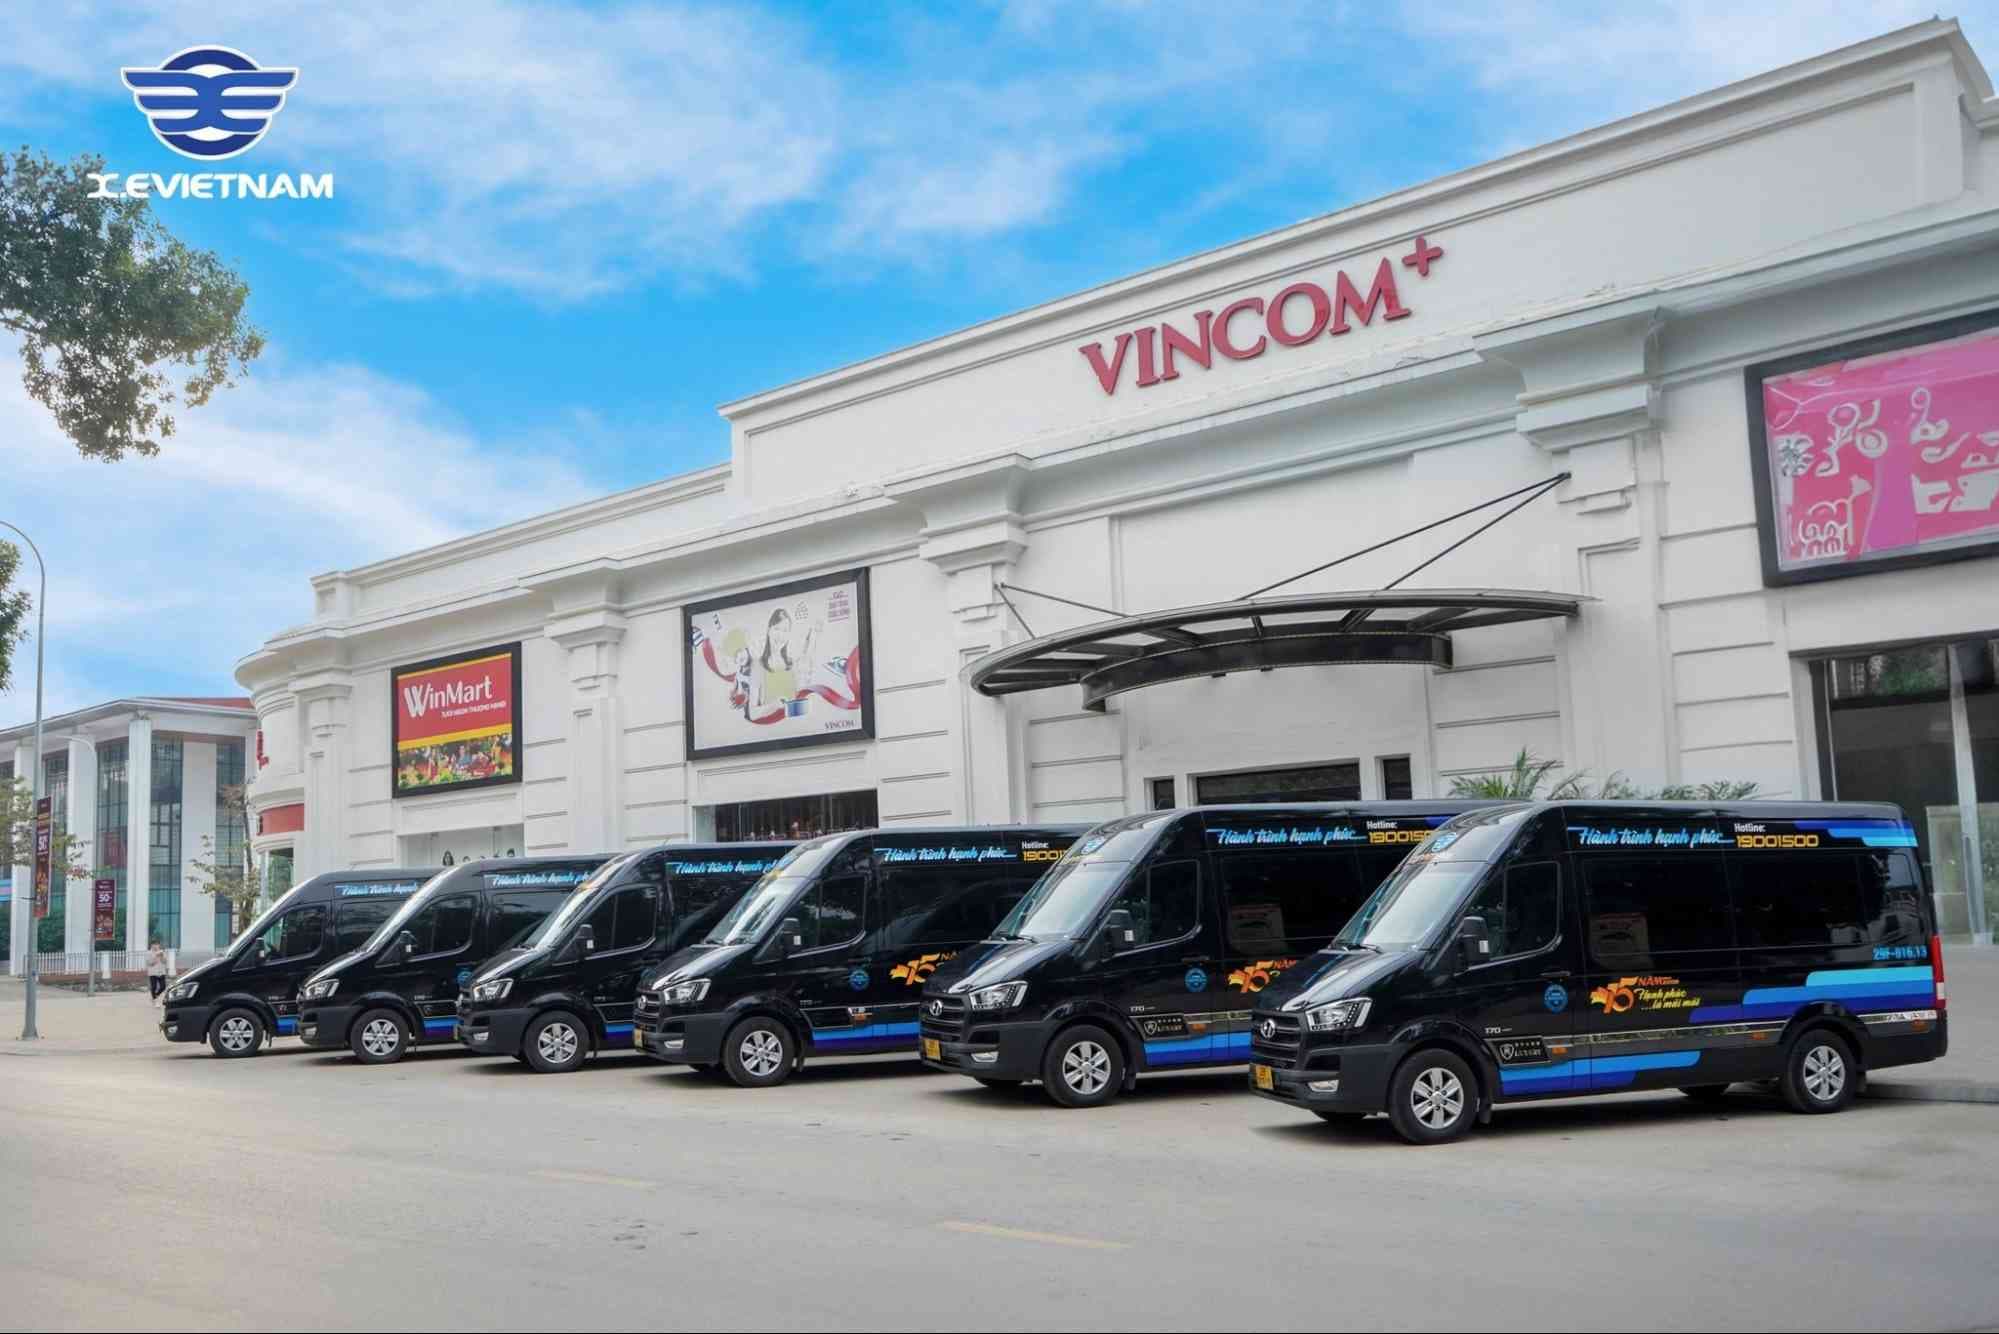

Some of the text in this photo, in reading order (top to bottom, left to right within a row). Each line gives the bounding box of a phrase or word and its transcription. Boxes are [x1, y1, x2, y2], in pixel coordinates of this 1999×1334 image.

[403, 675, 494, 718] WinMart
[1366, 820, 1398, 830] Hotline:
[1734, 822, 1766, 833] Hotline:
[1736, 834, 1819, 848] 19001500
